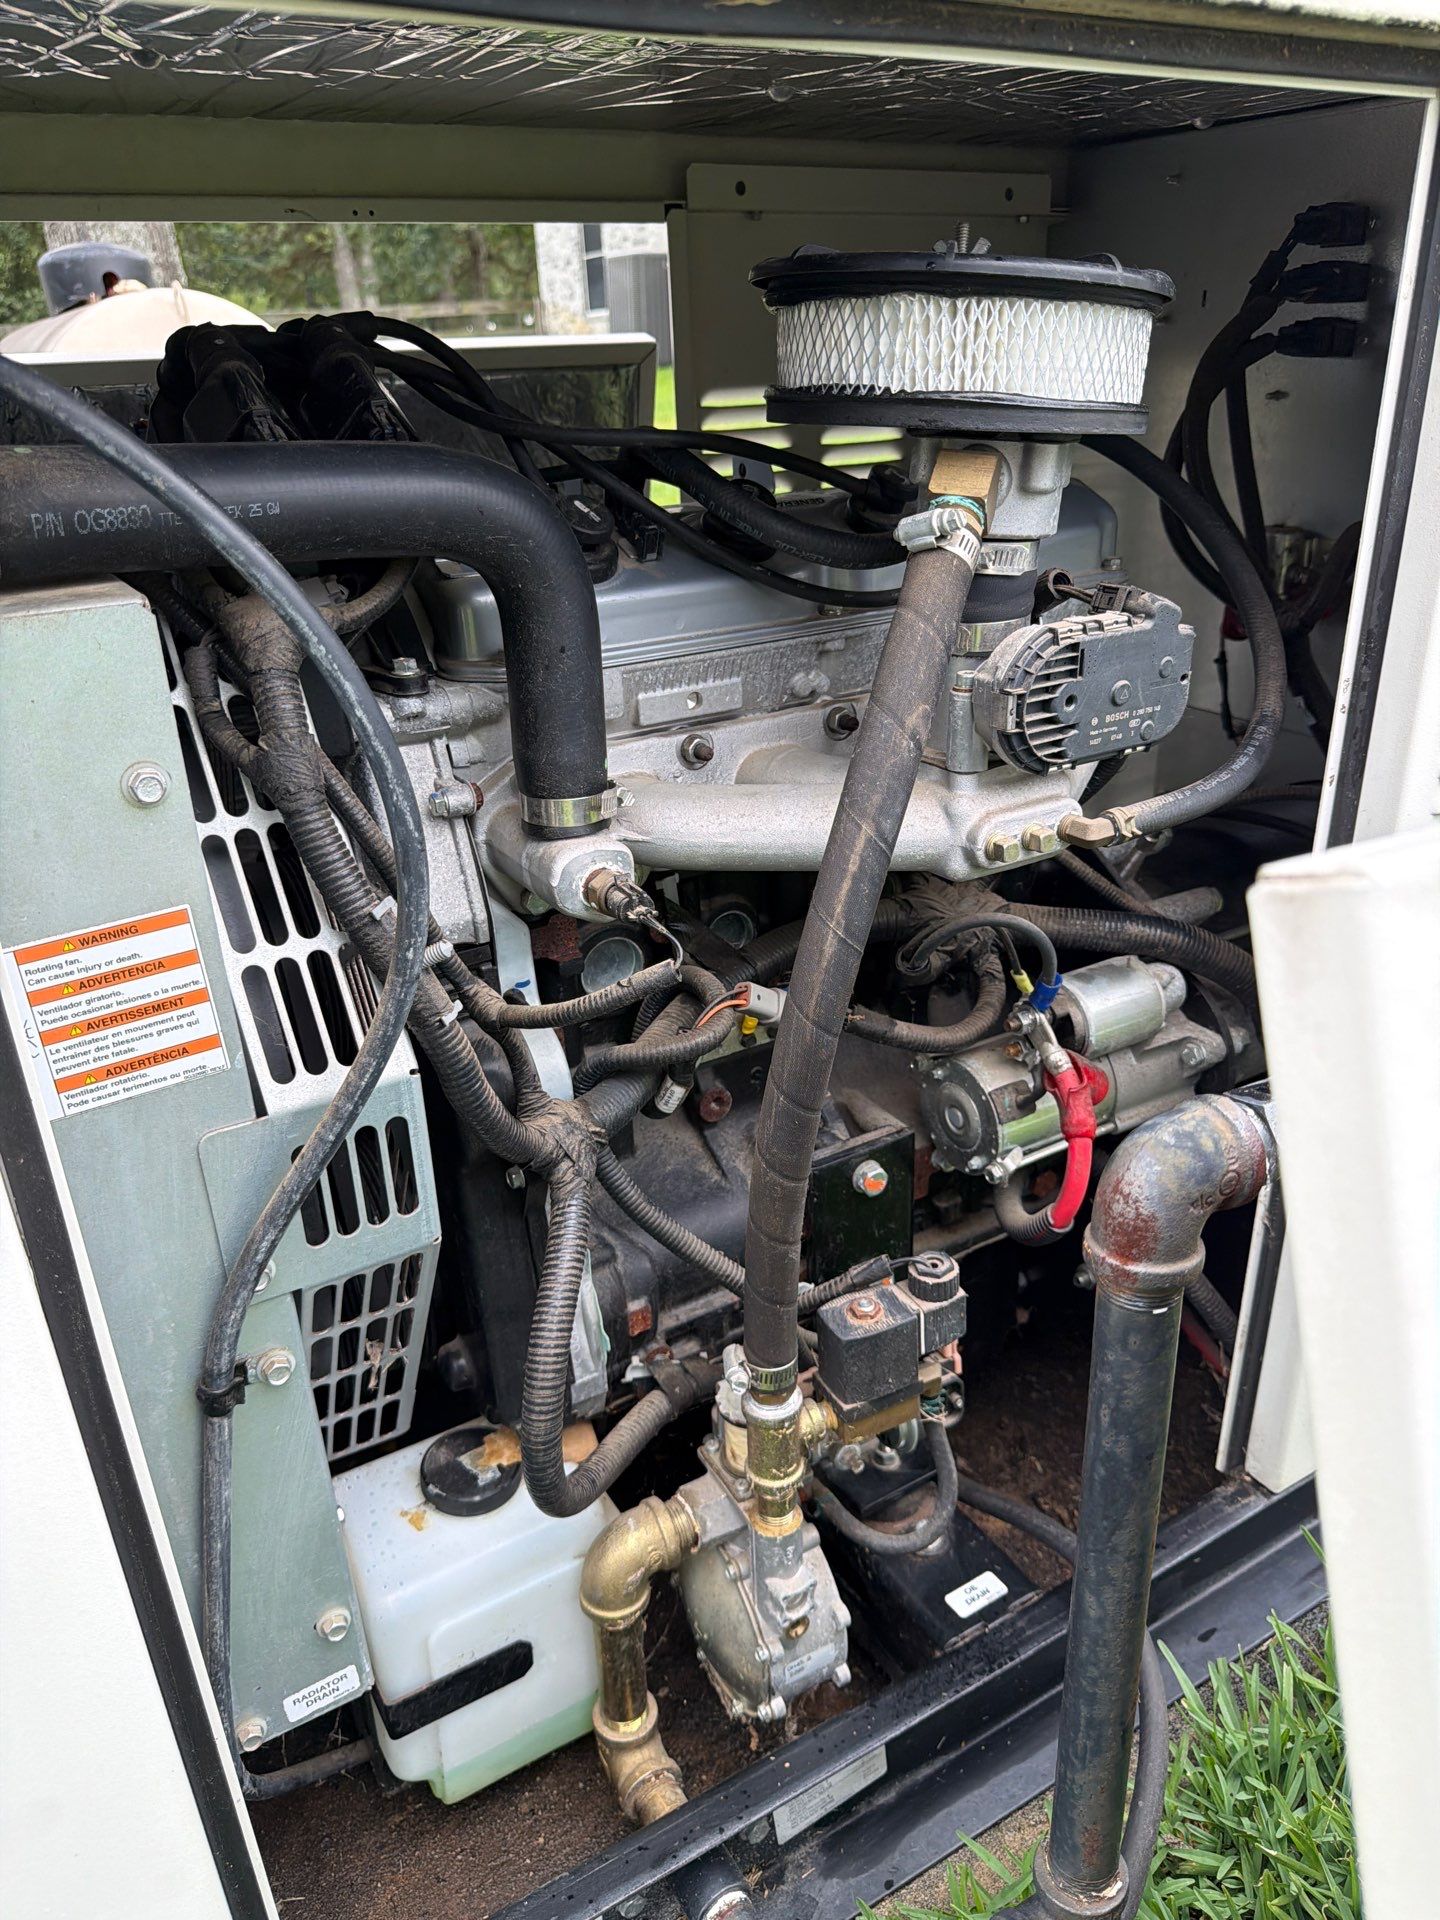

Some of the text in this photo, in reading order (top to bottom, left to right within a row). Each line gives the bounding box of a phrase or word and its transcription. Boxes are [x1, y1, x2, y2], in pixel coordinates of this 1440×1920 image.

[1105, 711, 1129, 723] BOSCH
[78, 926, 139, 947] WARNING
[25, 957, 82, 977] Rotating fan.
[28, 977, 46, 986] Can
[49, 970, 75, 981] cause
[77, 962, 102, 974] injury
[116, 952, 143, 964] death.
[79, 961, 166, 990] ADVERTENCIA
[37, 990, 124, 1017] Ventilador giratorio.
[41, 1014, 69, 1026] Puede
[71, 1003, 114, 1018] ocasionar
[116, 993, 152, 1008] lesiones
[162, 986, 169, 994] la
[171, 979, 202, 992] muerte.
[87, 997, 184, 1032] AVERTISSEMENT
[50, 1047, 61, 1056] Le
[63, 1034, 109, 1052] ventilateur
[125, 1017, 174, 1035] mouvement
[176, 1010, 195, 1022] peut
[95, 1042, 111, 1053] des
[113, 1032, 154, 1048] blessures
[157, 1025, 184, 1038] graves
[187, 1018, 200, 1028] qui
[55, 1059, 91, 1075] peuvent
[112, 1046, 138, 1058] fatale.
[105, 1047, 190, 1078] ADVERTÊNCIA
[64, 1072, 150, 1101] Ventilador rotatório.
[67, 1064, 210, 1110] Pode causar ferimentos ou morte.
[965, 1587, 990, 1605] DRAIN
[292, 1673, 348, 1706] RADIATOR
[305, 1686, 340, 1707] DRAIN
